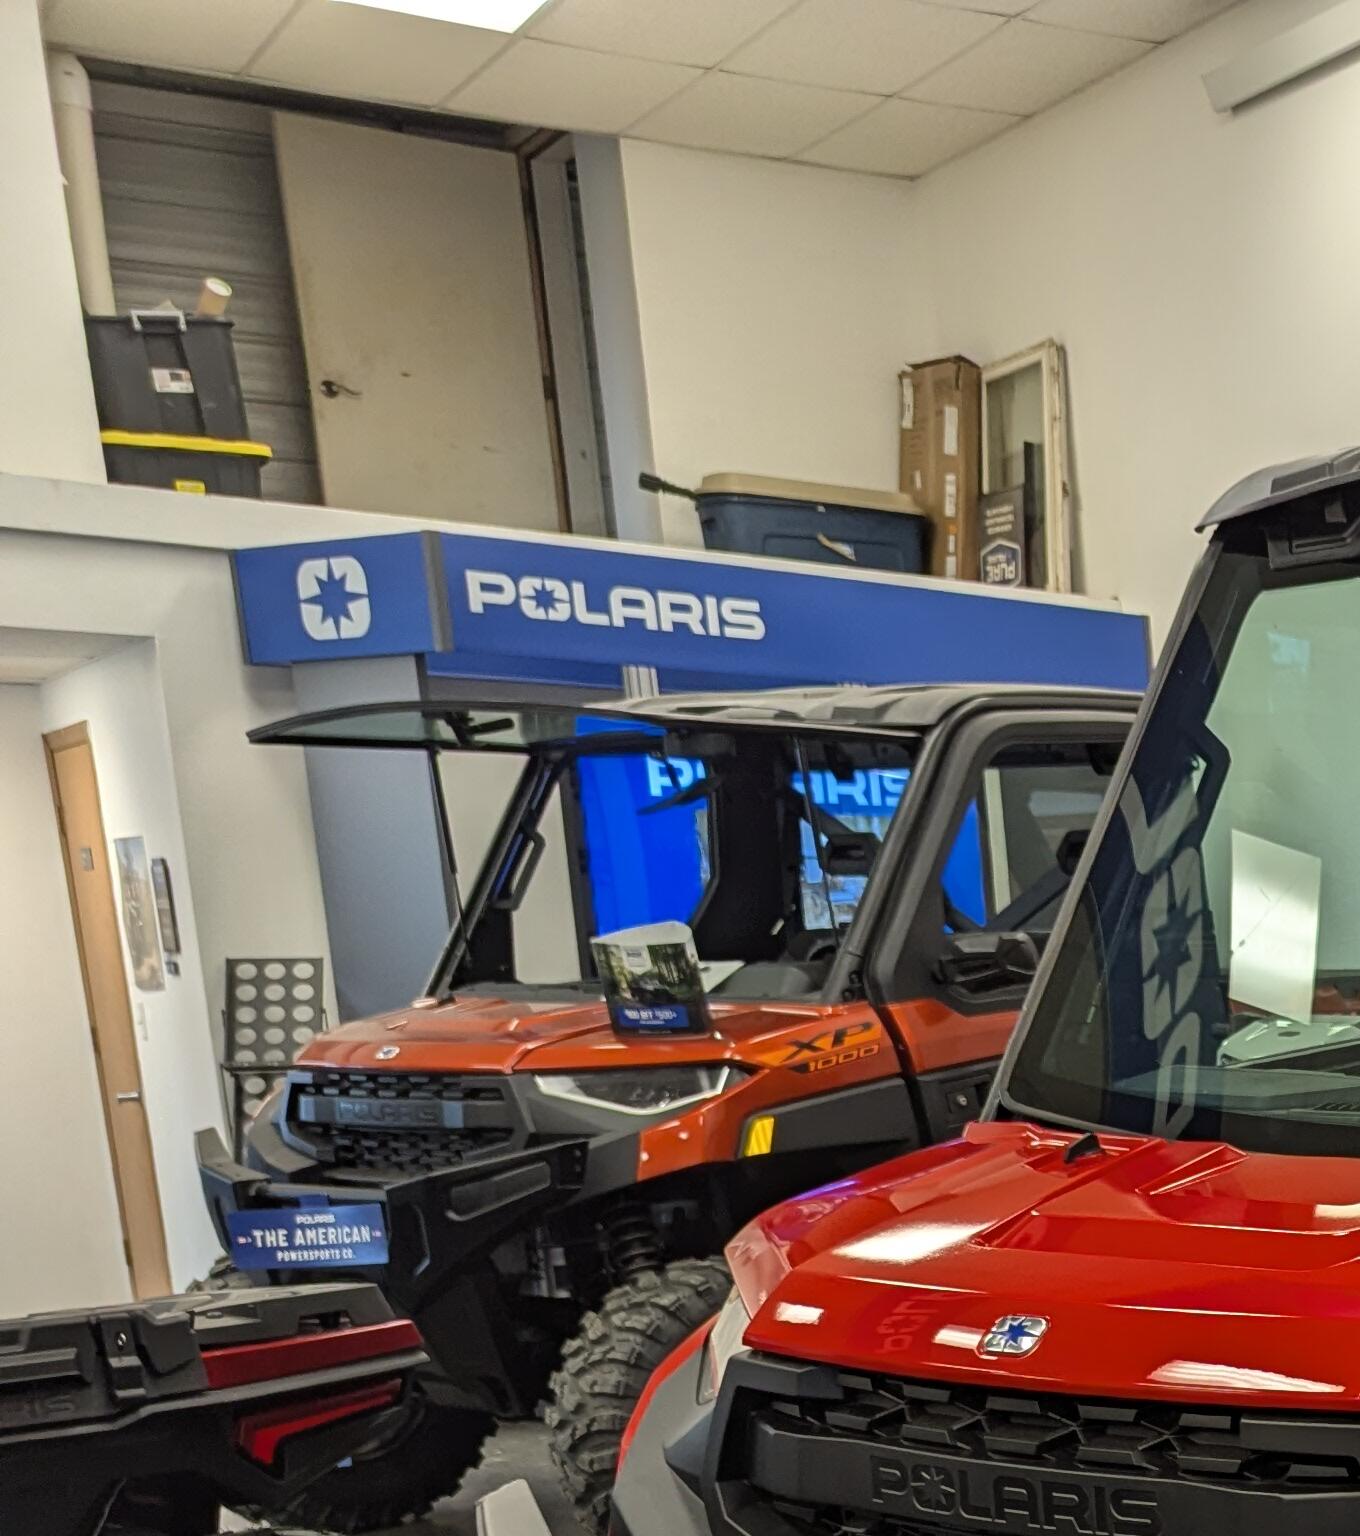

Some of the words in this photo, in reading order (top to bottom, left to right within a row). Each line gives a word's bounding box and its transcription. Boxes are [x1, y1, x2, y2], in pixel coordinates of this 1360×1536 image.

[465, 568, 766, 640] POLARIS
[780, 1021, 874, 1063] XP
[808, 1044, 879, 1072] 1000
[251, 1227, 289, 1248] THE
[294, 1225, 372, 1247] AMERICAN
[276, 1248, 341, 1263] POWERSPORTS
